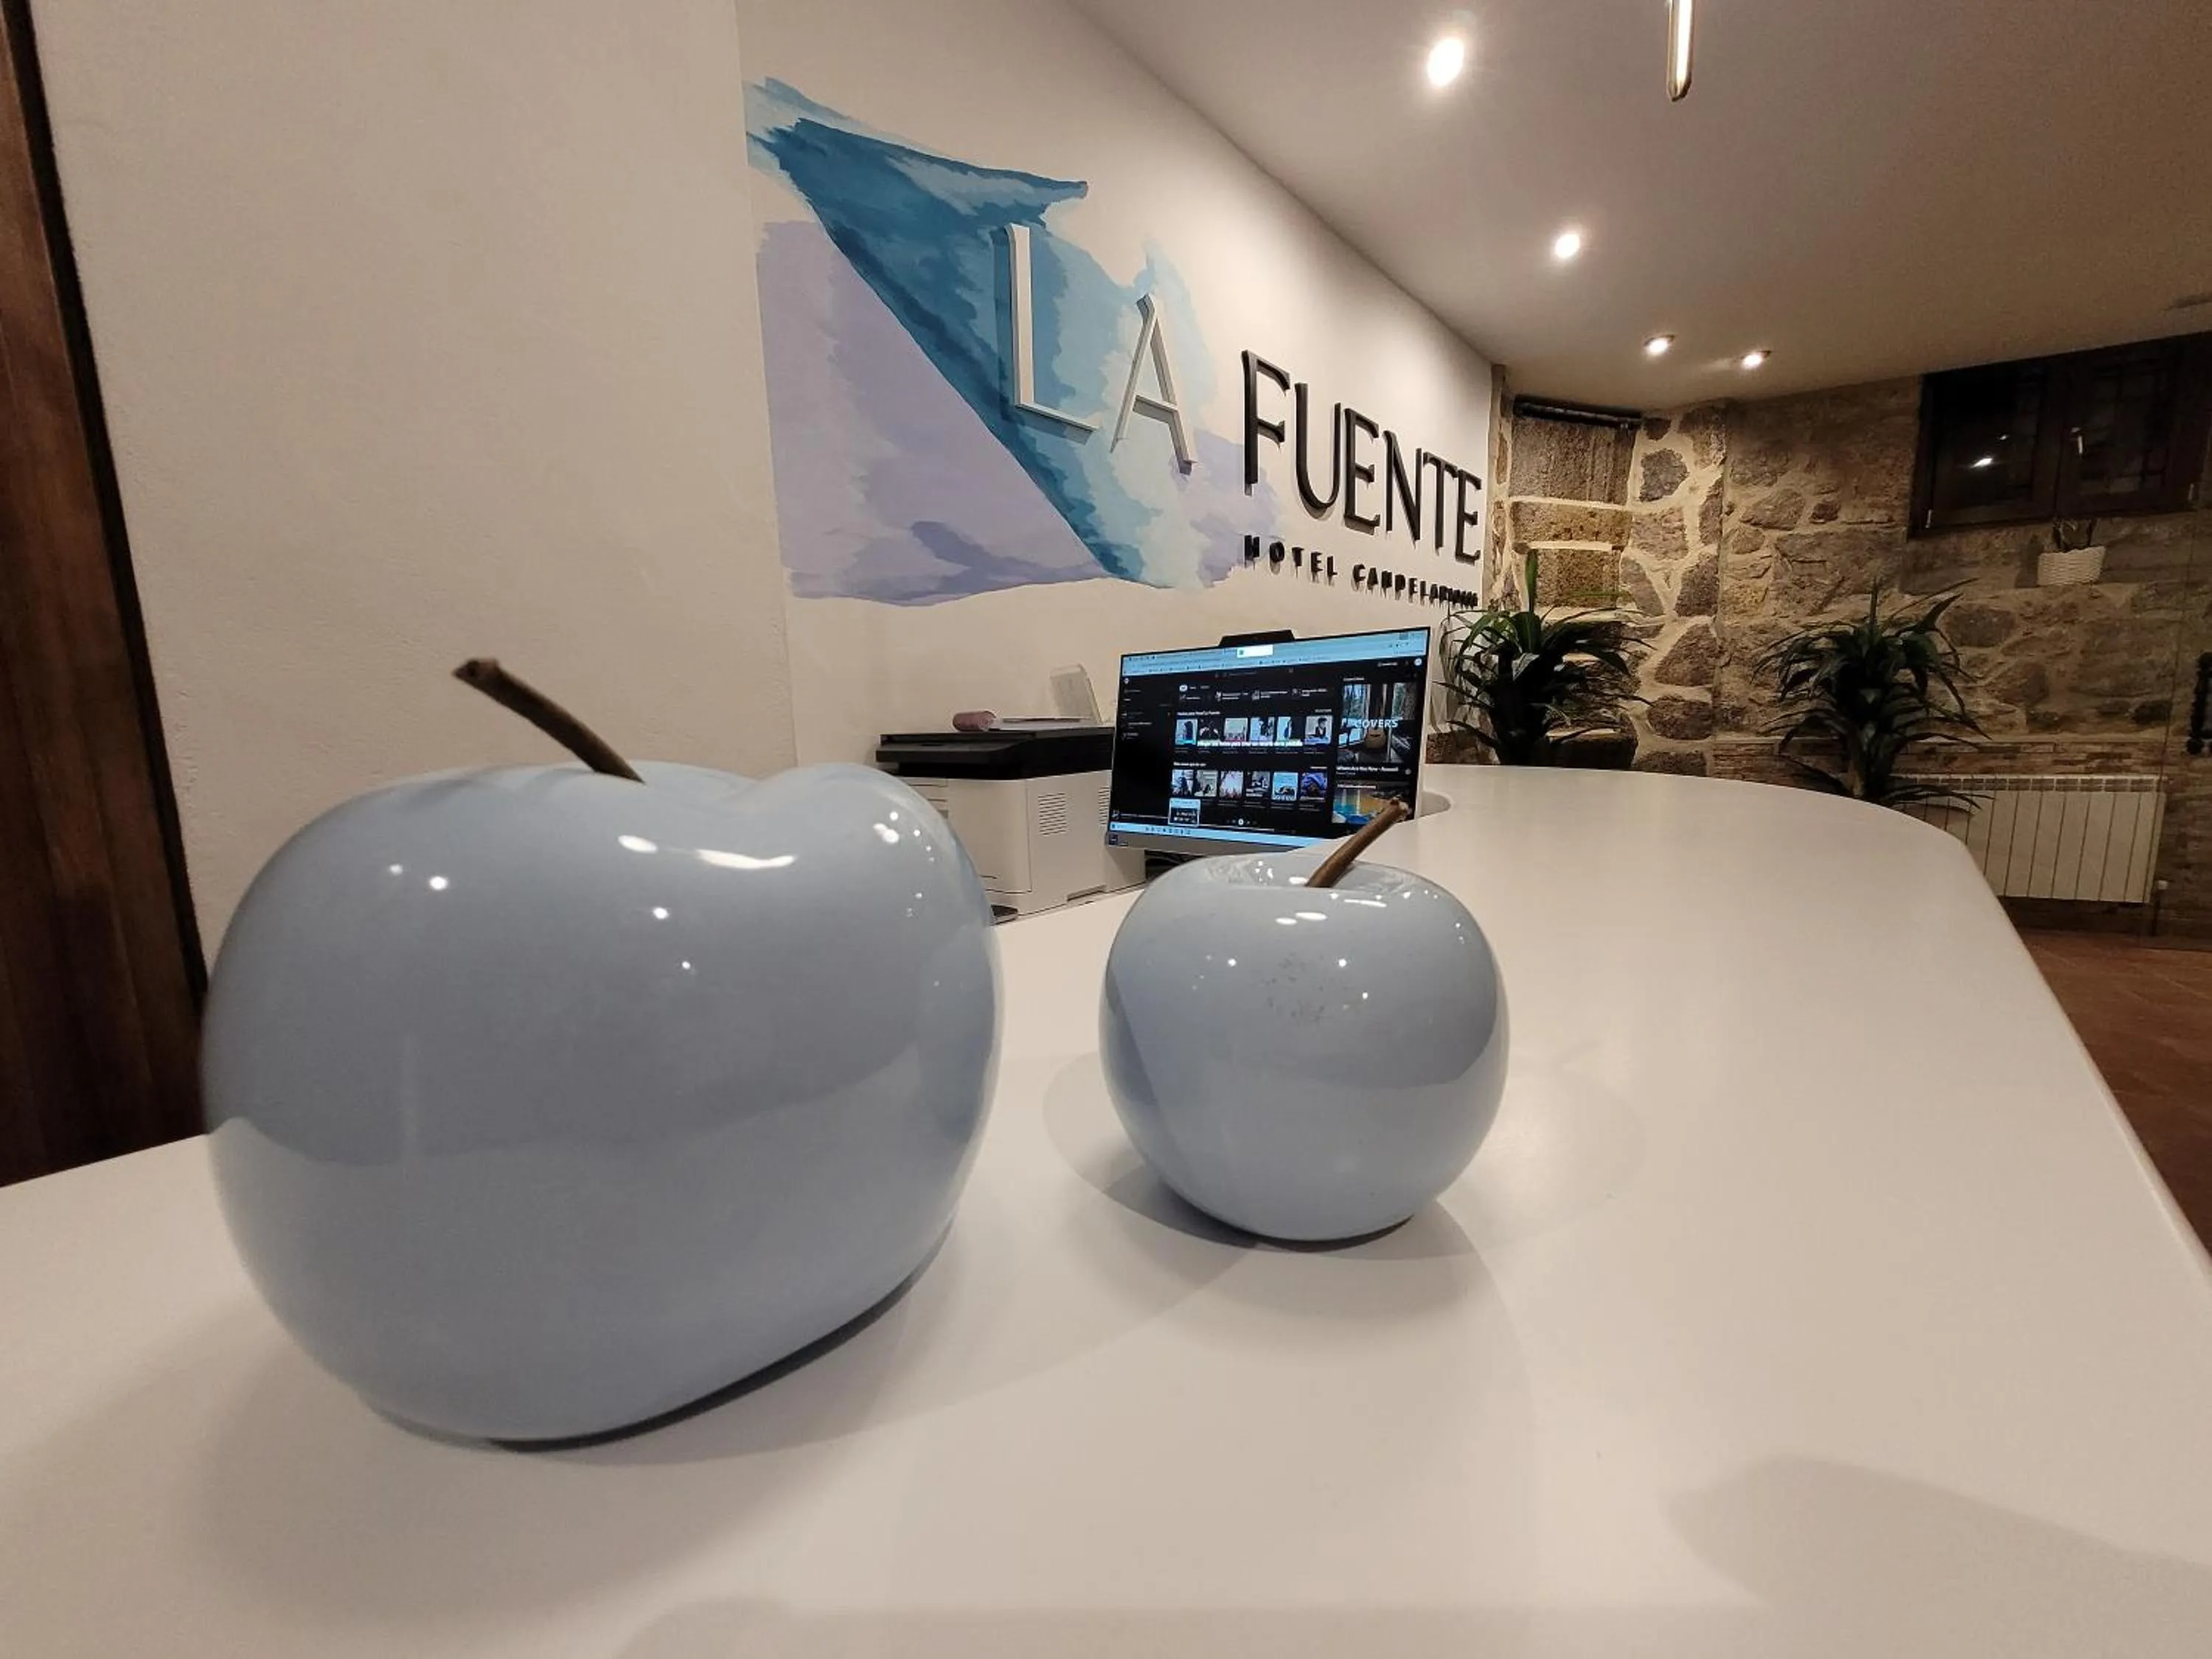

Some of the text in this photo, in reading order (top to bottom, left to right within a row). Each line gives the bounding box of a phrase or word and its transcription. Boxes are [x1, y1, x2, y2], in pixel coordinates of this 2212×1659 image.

[1004, 223, 1482, 563] LA FUENTE
[1245, 535, 1338, 576] HOTEL
